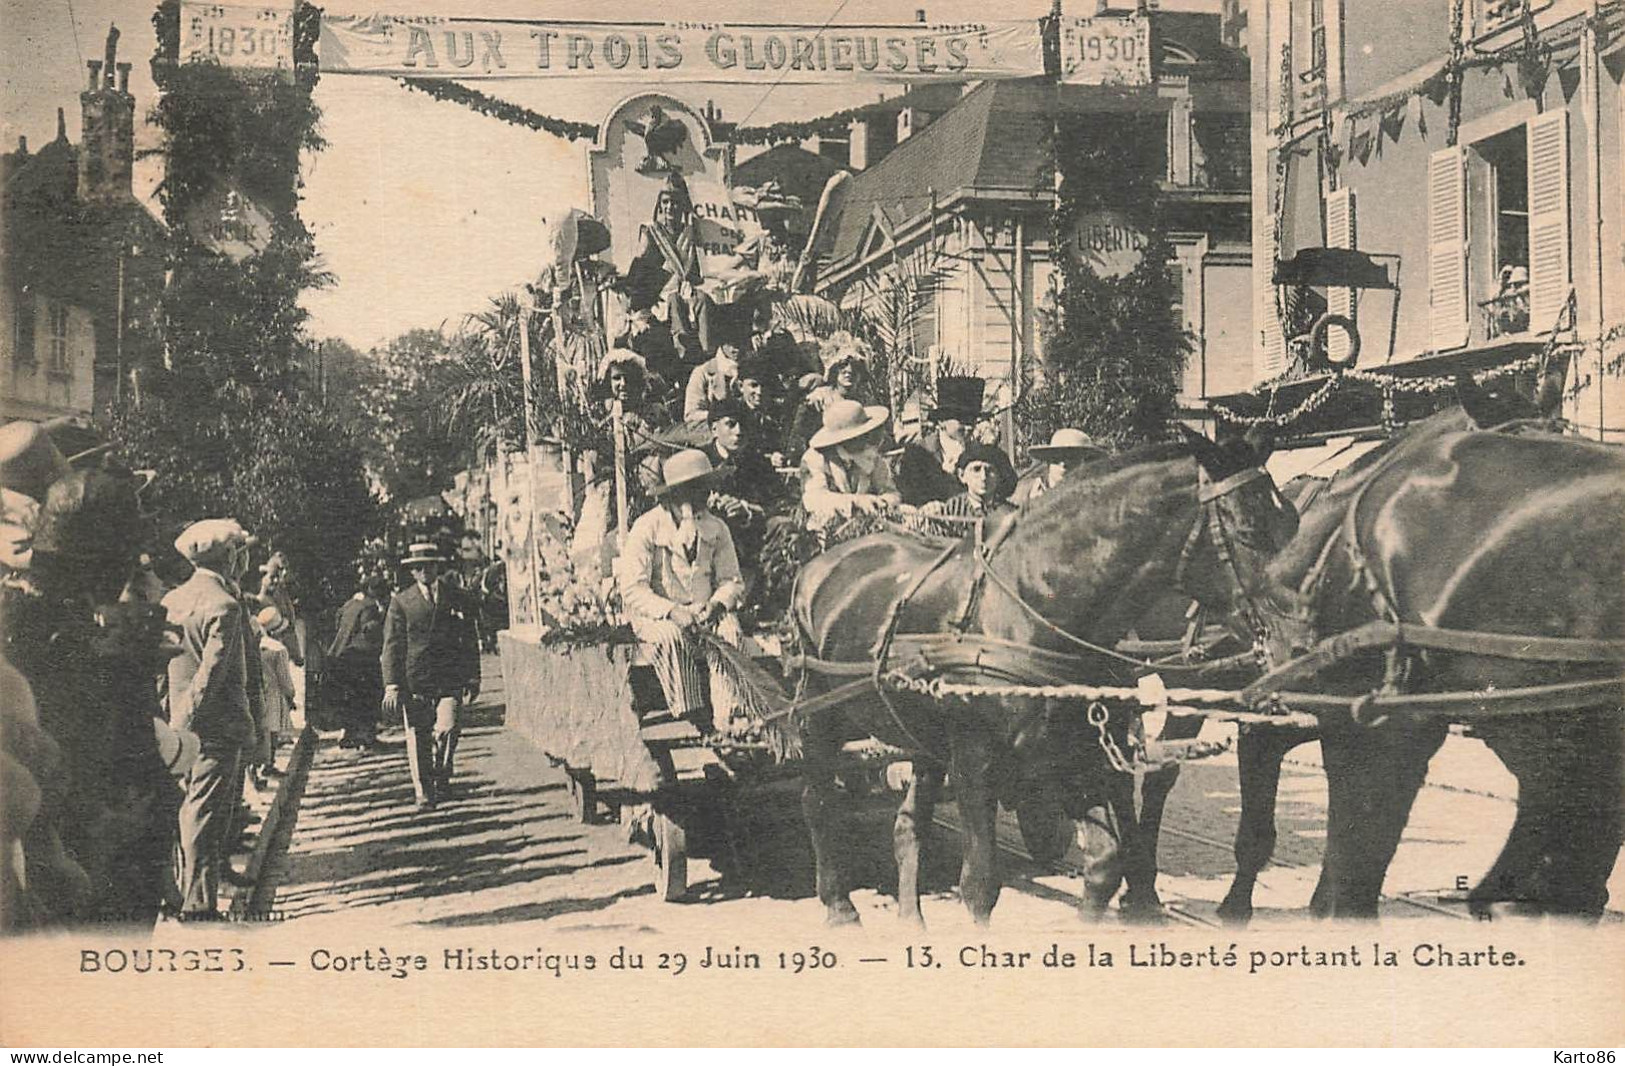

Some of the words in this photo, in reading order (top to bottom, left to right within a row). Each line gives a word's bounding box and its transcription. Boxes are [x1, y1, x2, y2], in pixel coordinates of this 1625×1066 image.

[208, 26, 277, 57] 1830
[402, 28, 507, 73] AUX
[530, 30, 683, 70] TROIS
[704, 32, 969, 73] GLORIEUSES
[1079, 36, 1136, 61] 1930
